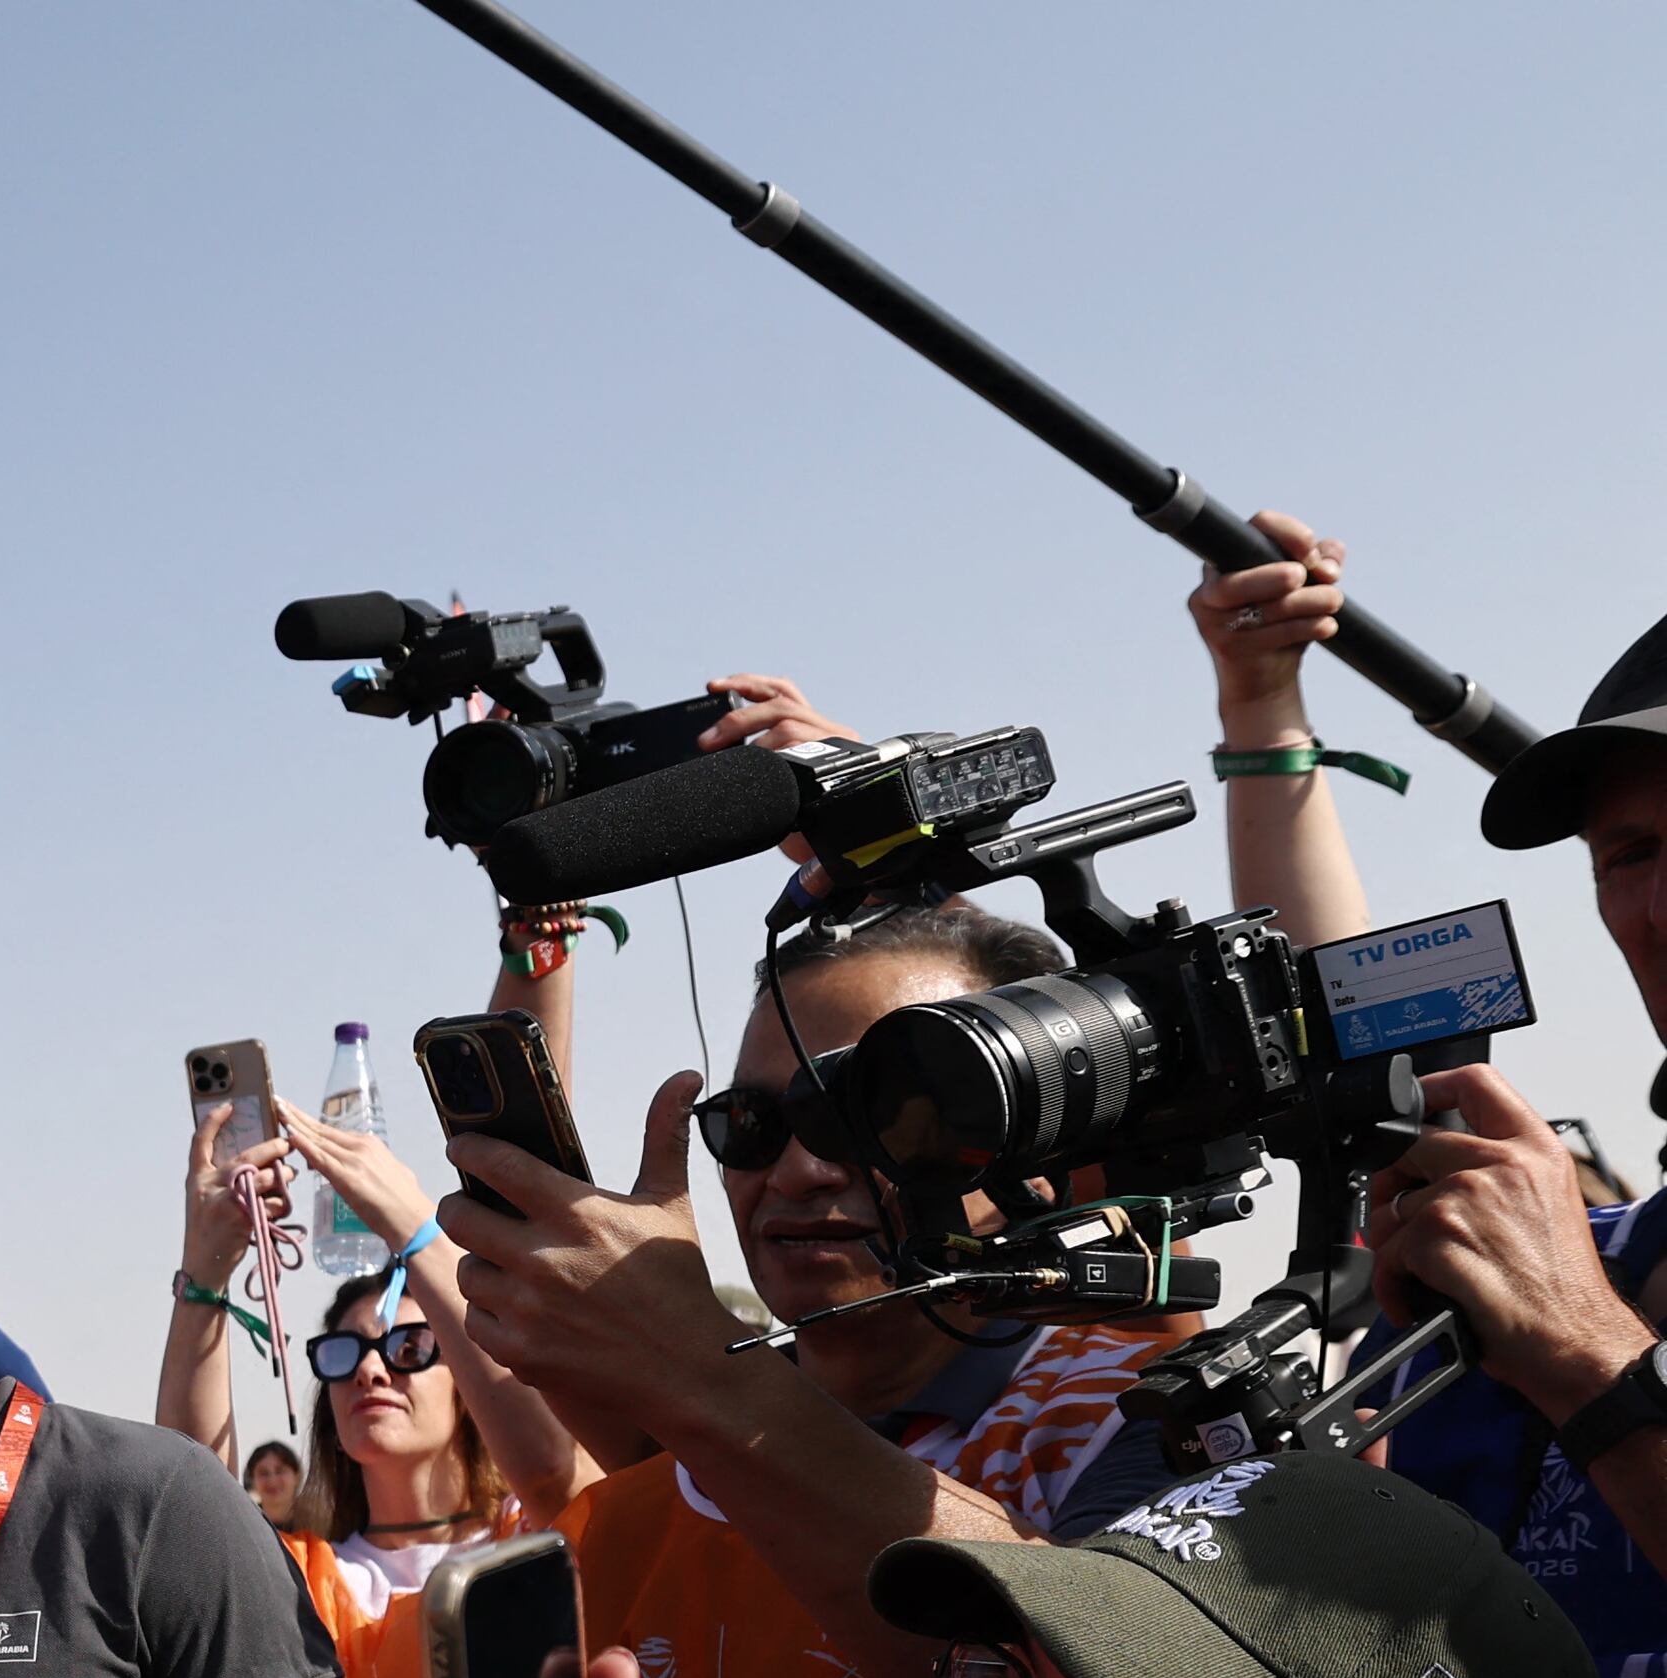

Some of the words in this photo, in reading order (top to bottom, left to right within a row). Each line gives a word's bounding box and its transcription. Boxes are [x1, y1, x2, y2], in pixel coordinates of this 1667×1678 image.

[1348, 947, 1385, 968] TV
[1392, 922, 1473, 957] ORGA
[1334, 994, 1356, 1008] Date
[1515, 1511, 1598, 1553] AKAR
[1529, 1560, 1579, 1578] 026
